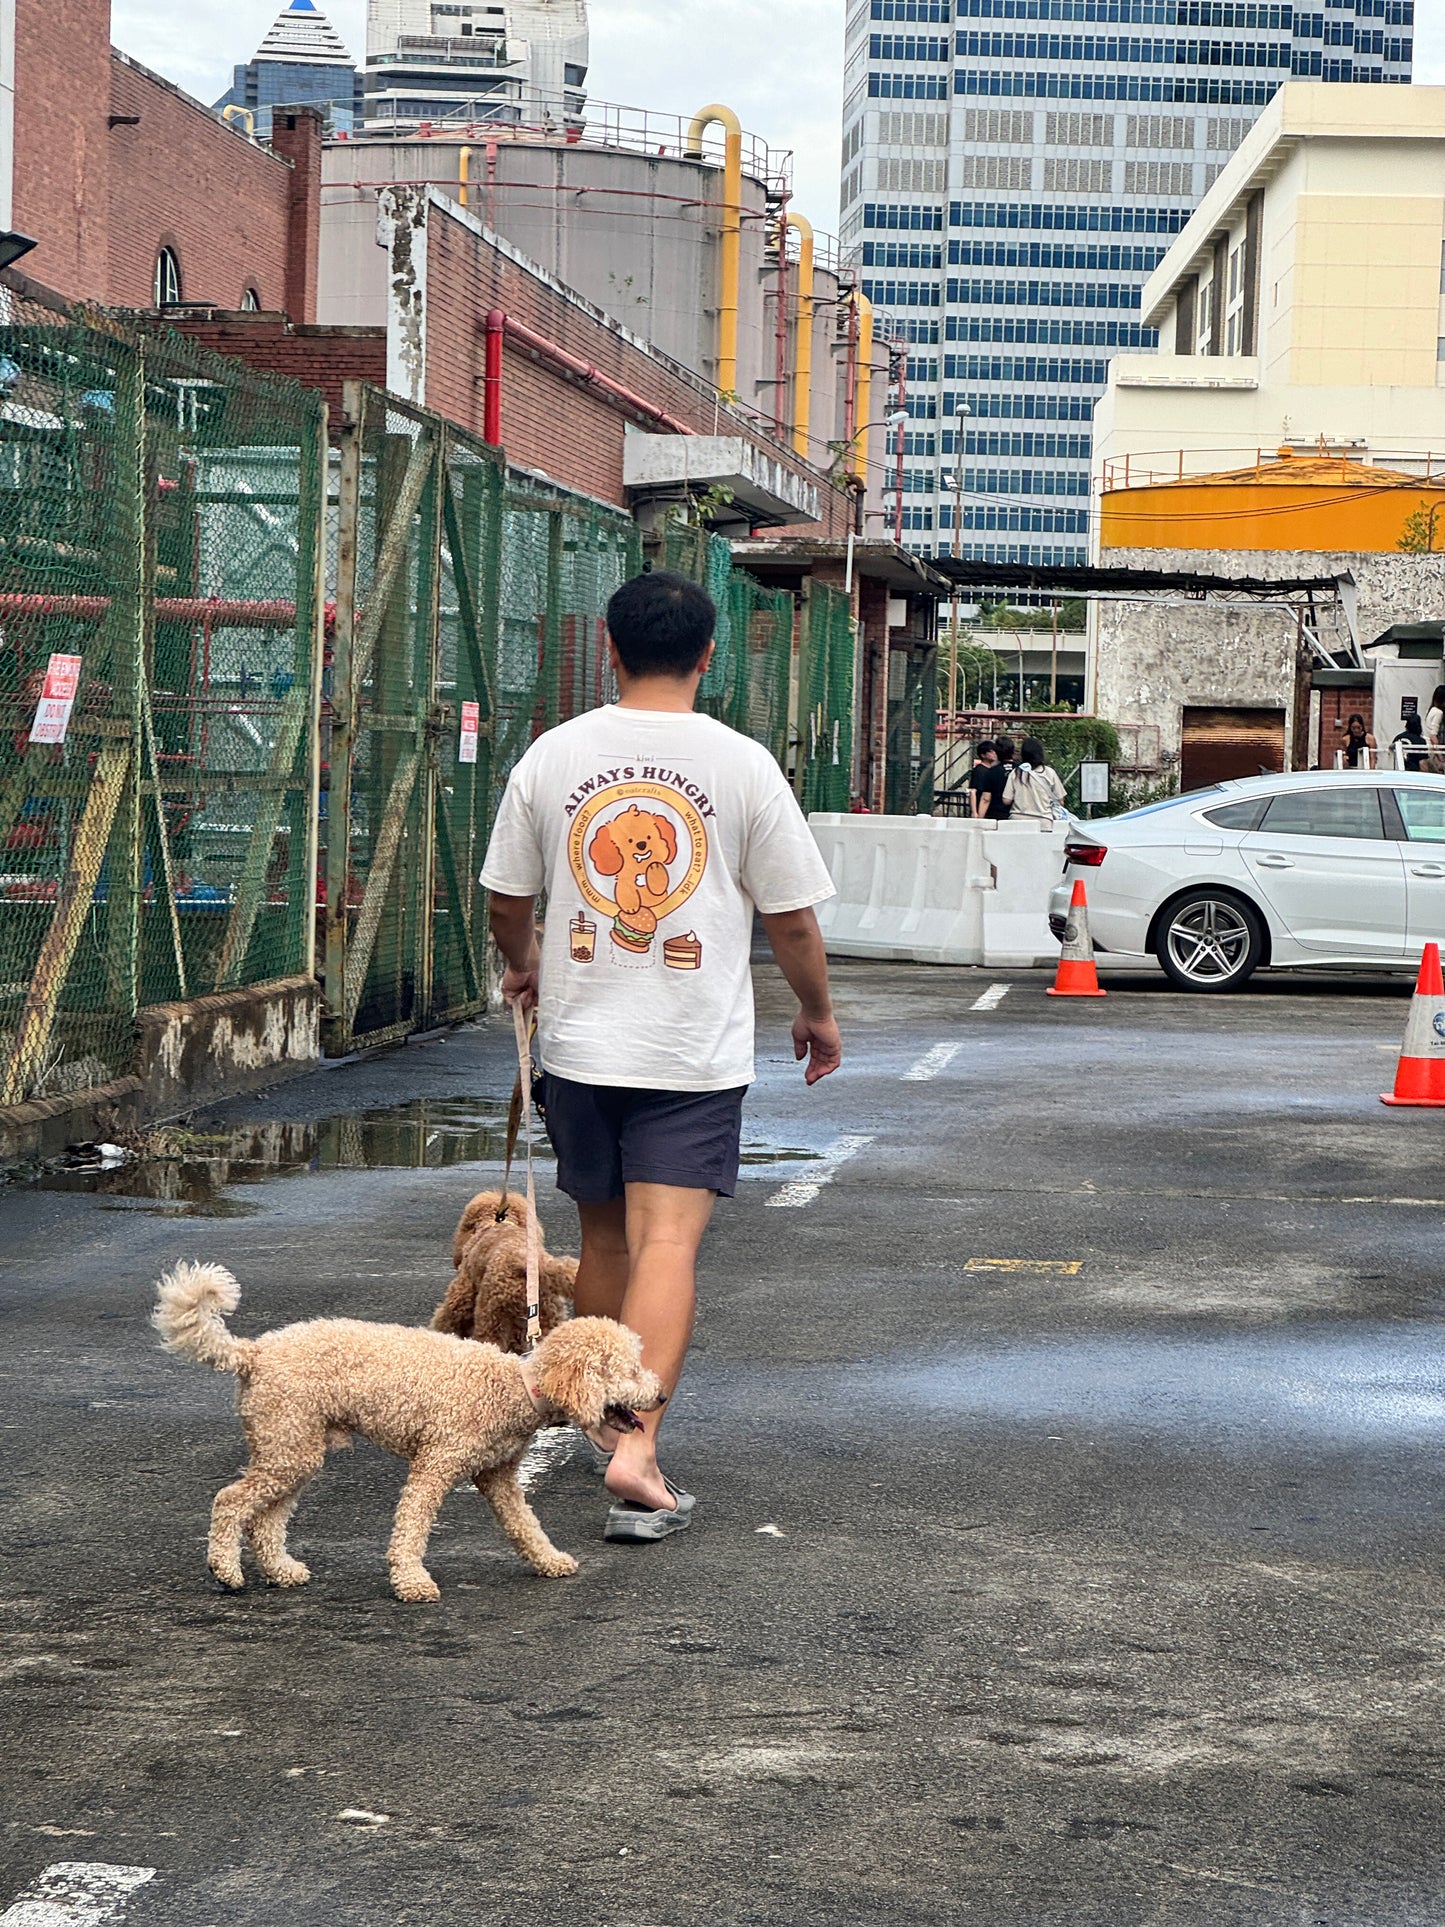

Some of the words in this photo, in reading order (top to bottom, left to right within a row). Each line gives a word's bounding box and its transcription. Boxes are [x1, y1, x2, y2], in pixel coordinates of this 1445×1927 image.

[564, 766, 635, 818] ALWAYS
[641, 766, 717, 819] HUNGRY
[573, 809, 593, 838] food?
[685, 811, 702, 838] what
[572, 839, 583, 872] where
[694, 837, 703, 848] to
[692, 852, 702, 874] eat?
